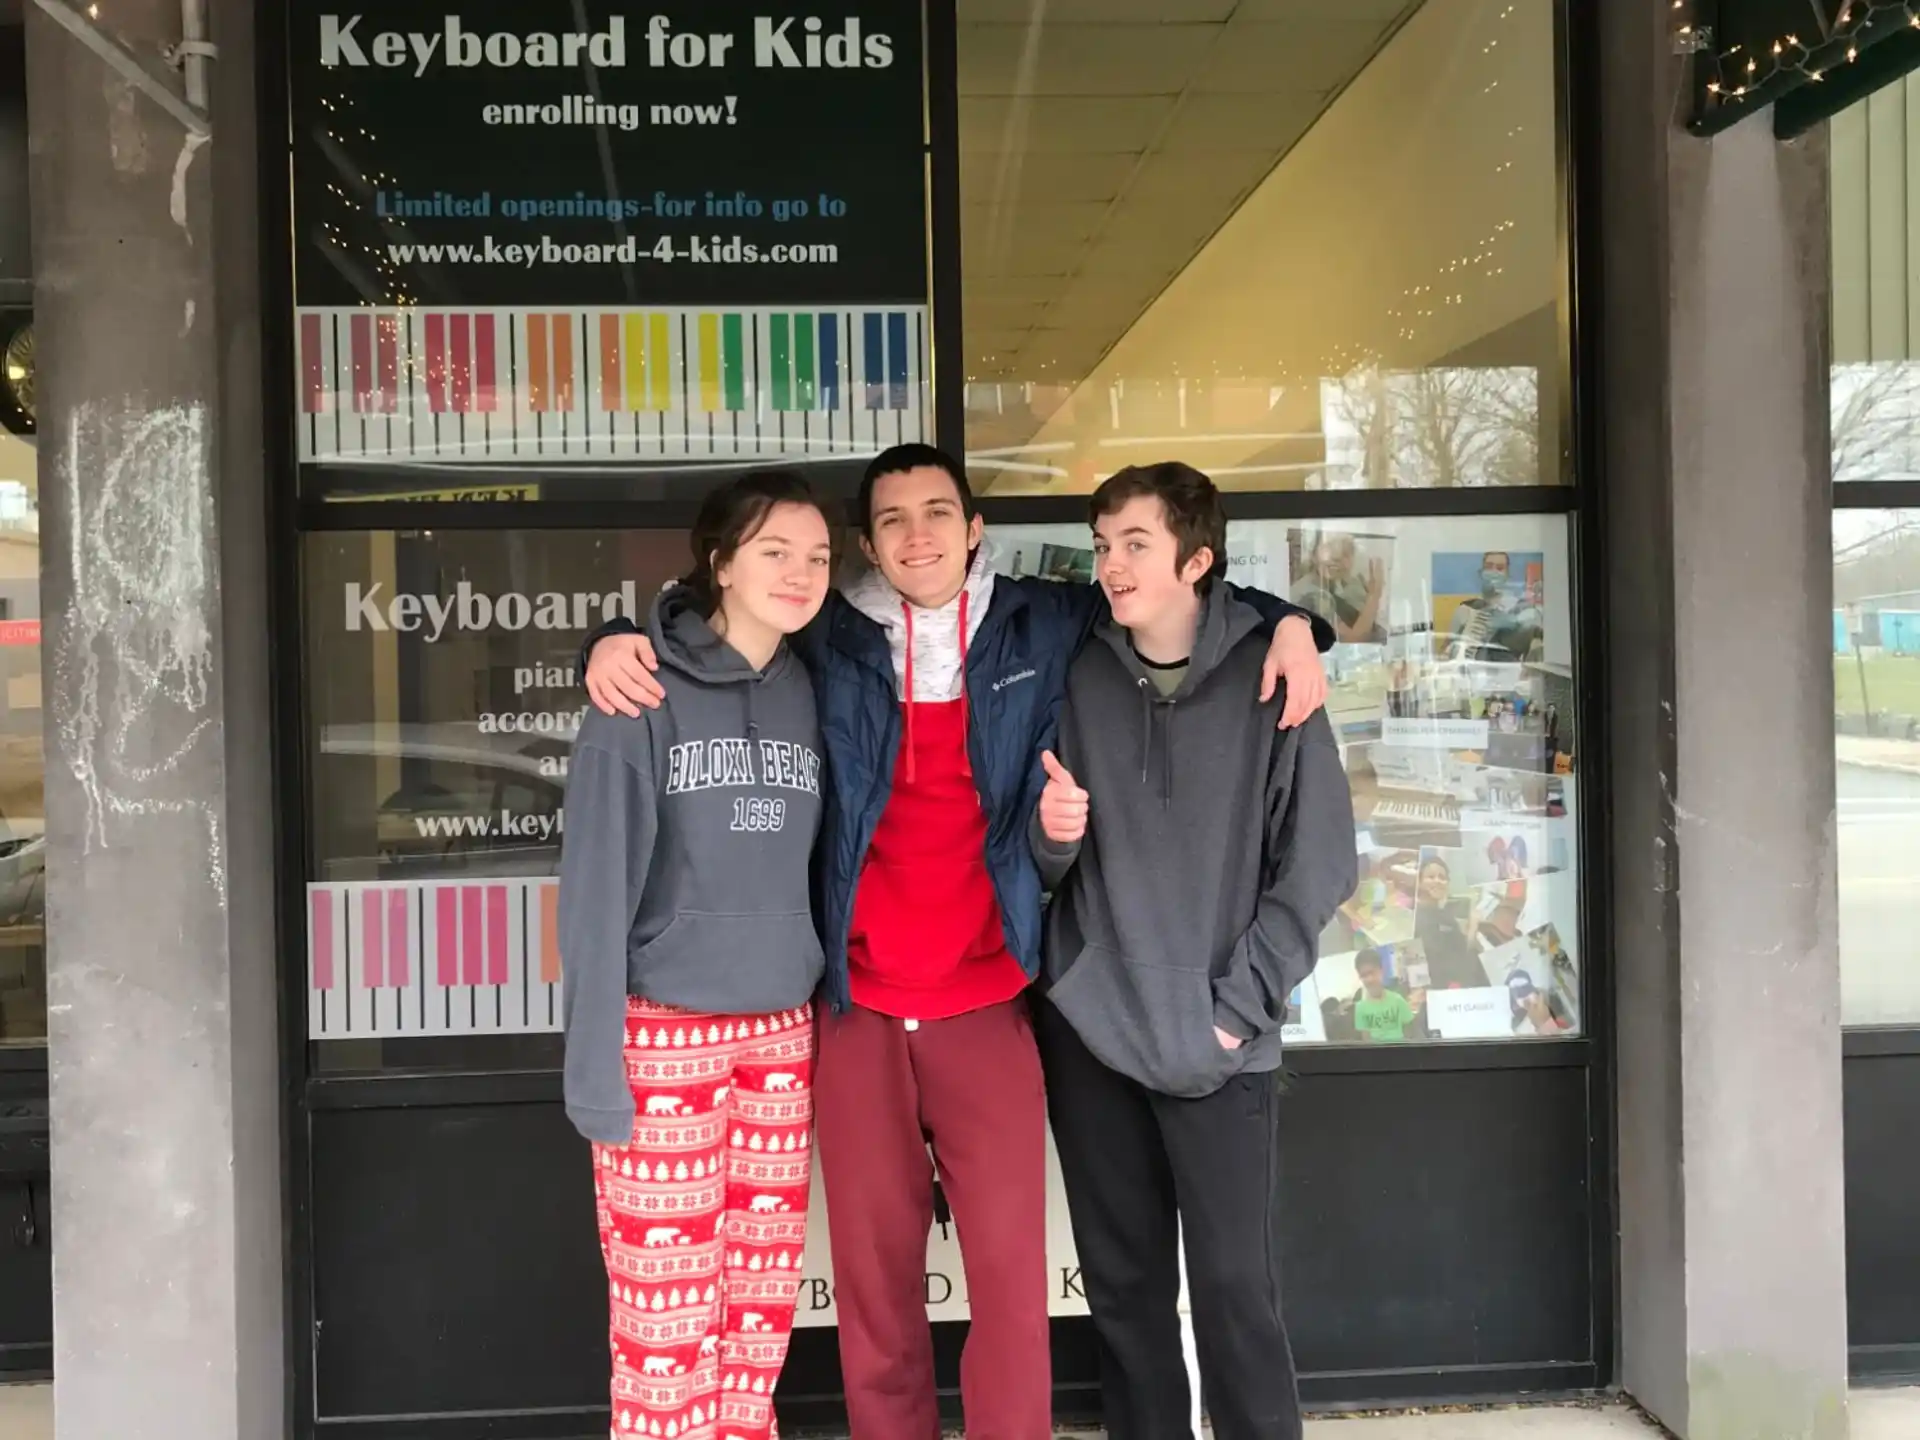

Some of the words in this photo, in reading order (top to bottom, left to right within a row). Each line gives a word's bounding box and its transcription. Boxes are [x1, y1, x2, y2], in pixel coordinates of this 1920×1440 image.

[320, 15, 626, 77] Keyboard
[644, 15, 733, 67] for
[754, 16, 894, 67] Kids
[482, 95, 639, 131] enrolling
[650, 95, 738, 125] now!
[376, 191, 490, 217] Limited
[501, 191, 696, 222] openings-for
[705, 191, 763, 217] info
[772, 199, 809, 222] go
[818, 193, 847, 217] to
[387, 235, 838, 269] www.keyboard-4-kids.com
[1249, 552, 1268, 566] ON
[344, 580, 636, 642] Keyboard
[514, 661, 579, 694] pian
[478, 705, 589, 735] accord
[665, 738, 755, 795] BILOXI
[758, 739, 821, 800] BEAC
[730, 796, 786, 832] 1699
